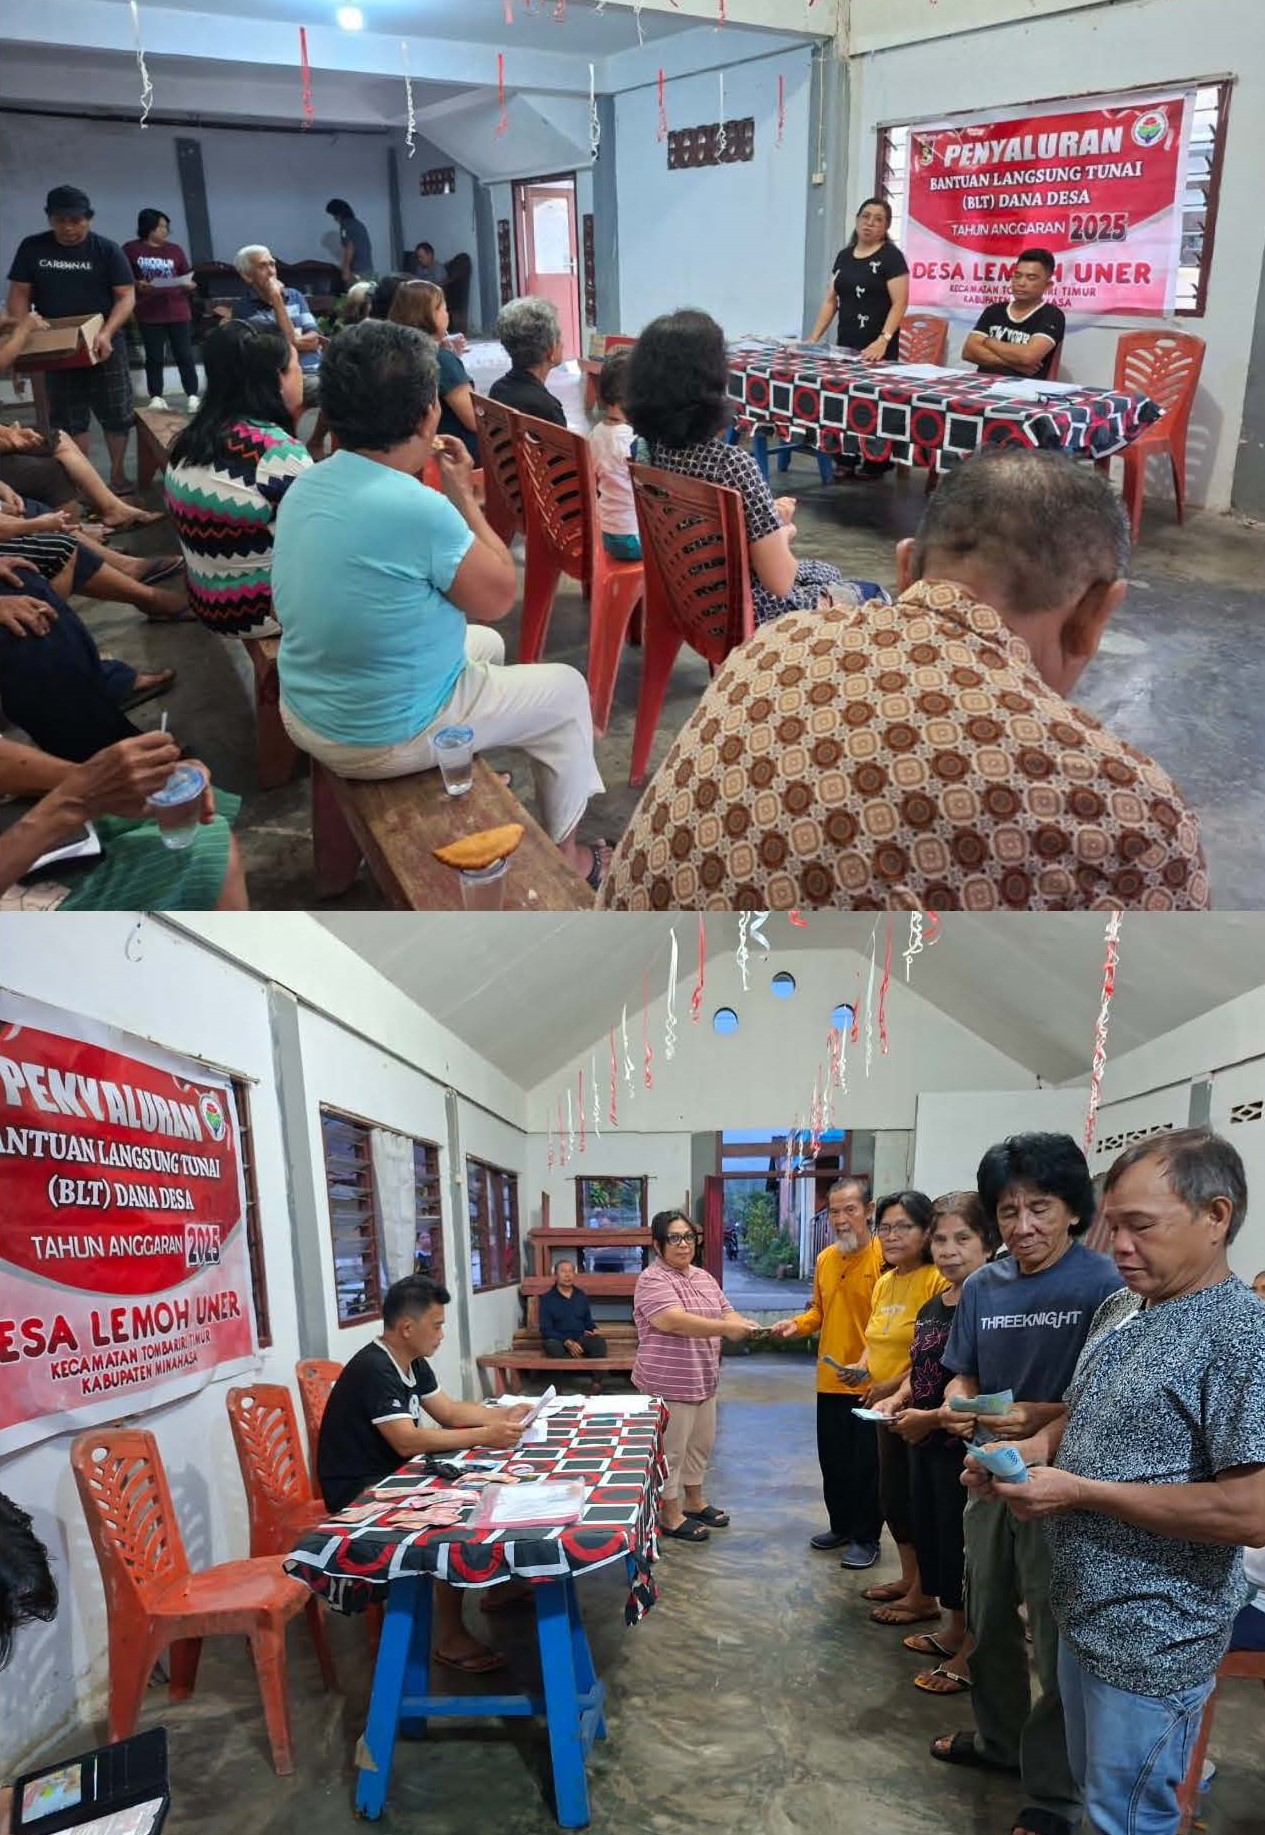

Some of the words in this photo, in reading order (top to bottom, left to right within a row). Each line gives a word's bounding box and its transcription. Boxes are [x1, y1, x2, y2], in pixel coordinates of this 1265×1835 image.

[943, 126, 1123, 168] PENYALURAN
[930, 173, 990, 191] BANTUAN
[993, 165, 1082, 187] LANGSUNG
[1085, 161, 1144, 180] TUNAI
[962, 193, 995, 211] (BLT)
[998, 191, 1043, 208] DANA
[1046, 188, 1091, 206] DESA
[951, 223, 990, 237] TAHUN
[991, 221, 1066, 236] ANGGARAN
[1070, 213, 1128, 242] 2025
[912, 261, 965, 280] DESA
[972, 261, 1063, 283] LEMH
[1074, 261, 1151, 284] UNER
[1062, 286, 1097, 297] TIMUR
[0, 1055, 204, 1143] PENYALURAN
[98, 1140, 181, 1175] LANGSUNG
[179, 1153, 221, 1179] TUNAI
[48, 1173, 111, 1209] (BLT)
[114, 1182, 160, 1210] DANA
[159, 1186, 195, 1210] DESA
[30, 1235, 105, 1260] TAHUN
[109, 1233, 184, 1258] ANGGARAN
[186, 1225, 220, 1265] 2025
[90, 1298, 190, 1347] LEMOH
[195, 1290, 241, 1325] UNER
[980, 1310, 1083, 1331] THREEKNIGHT
[50, 1348, 138, 1380] KECAMATAN
[142, 1335, 188, 1361] TOMBARIRI
[188, 1329, 211, 1349] TIMUR
[81, 1365, 153, 1395] KABUPATEN
[154, 1351, 198, 1377] MINAHASA
